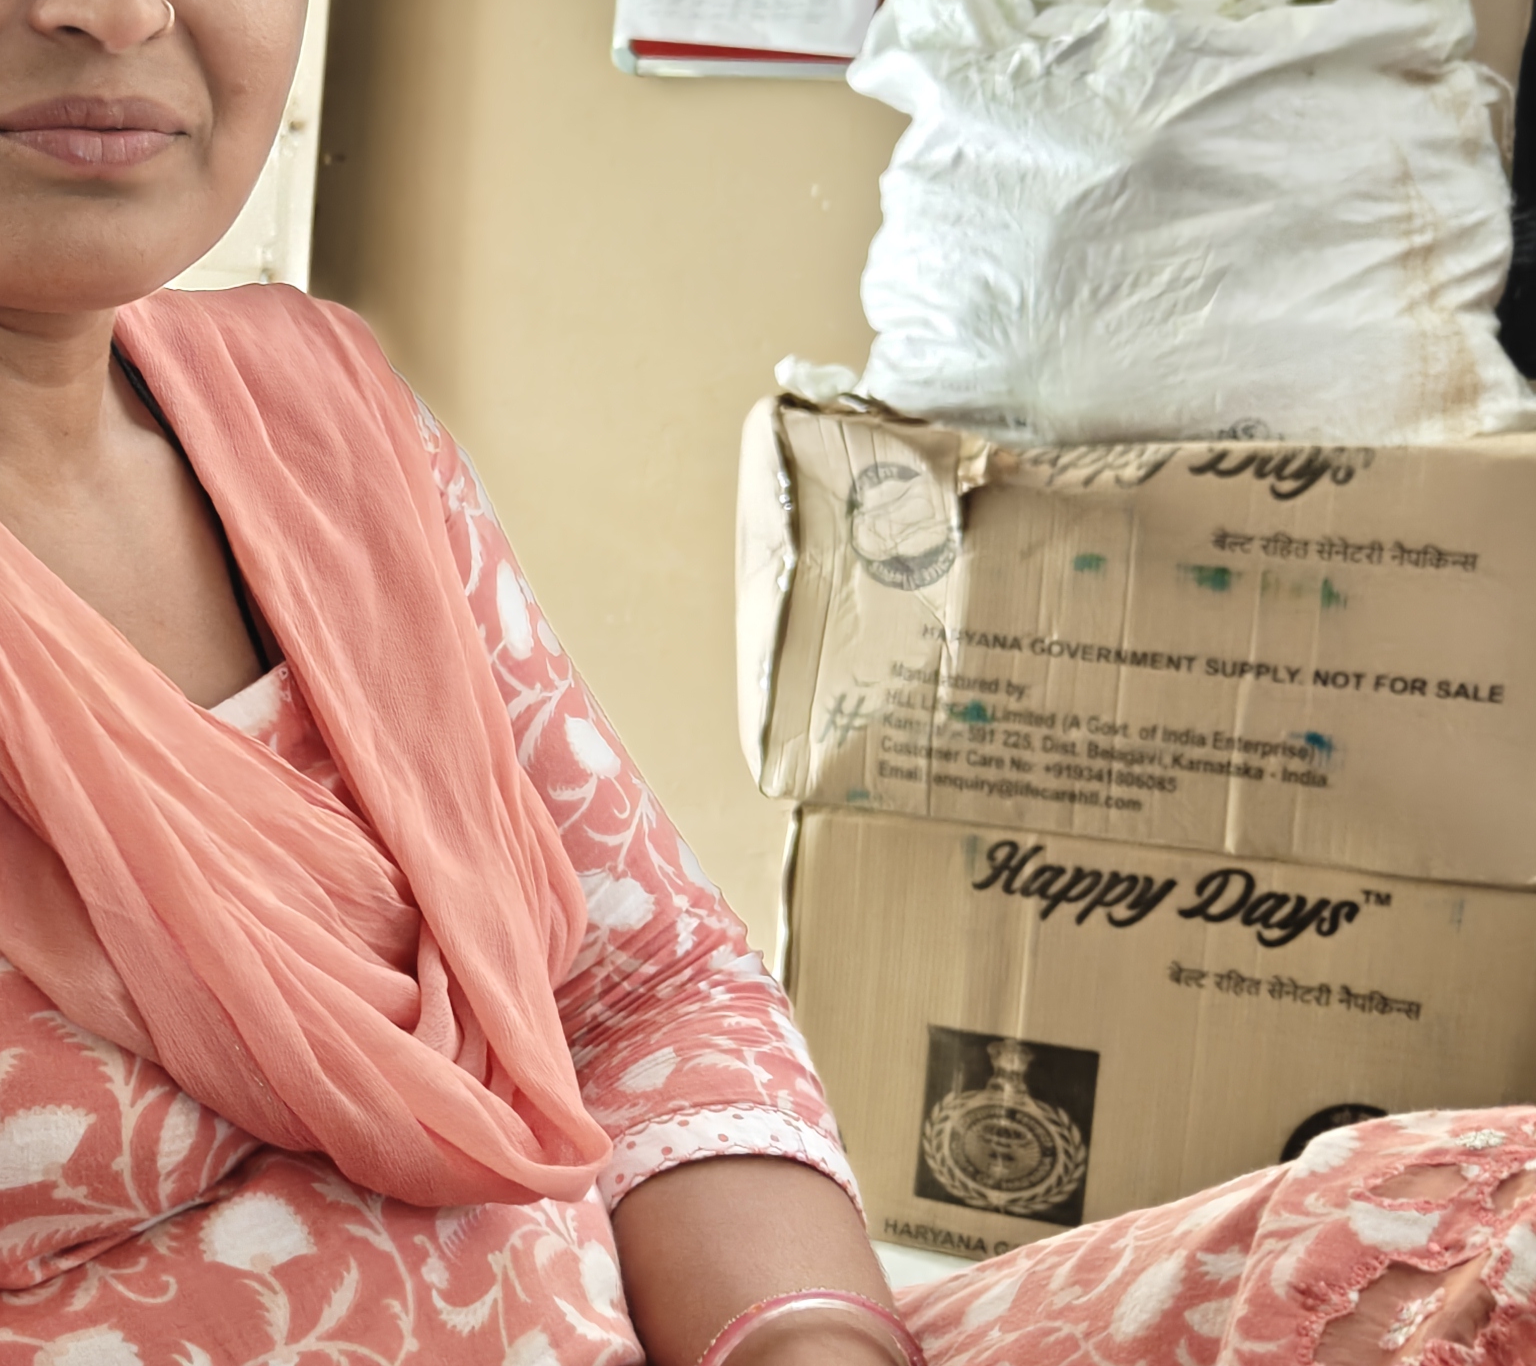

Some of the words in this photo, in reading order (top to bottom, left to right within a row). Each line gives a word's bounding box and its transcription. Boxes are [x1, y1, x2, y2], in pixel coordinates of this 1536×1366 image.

[1211, 527, 1254, 554] बेल्ट
[1260, 531, 1311, 560] रहित
[1316, 536, 1384, 565] सेनेटरी
[1029, 637, 1198, 676] GOVERNMENT
[1312, 668, 1366, 693] NOT
[1372, 672, 1428, 698] FOR
[1434, 679, 1506, 706] SALE
[1138, 724, 1159, 741] of
[1161, 726, 1208, 748] India
[966, 748, 1006, 770] Care
[1170, 753, 1266, 781] Karnataka
[1280, 767, 1329, 787] India
[972, 839, 1178, 929] Happy
[1176, 867, 1361, 949] Days
[1167, 960, 1209, 989] बेल्ट
[1213, 968, 1263, 997] रहित
[1267, 973, 1332, 1008] सेनेटरी
[883, 1217, 989, 1256] HARYANA
